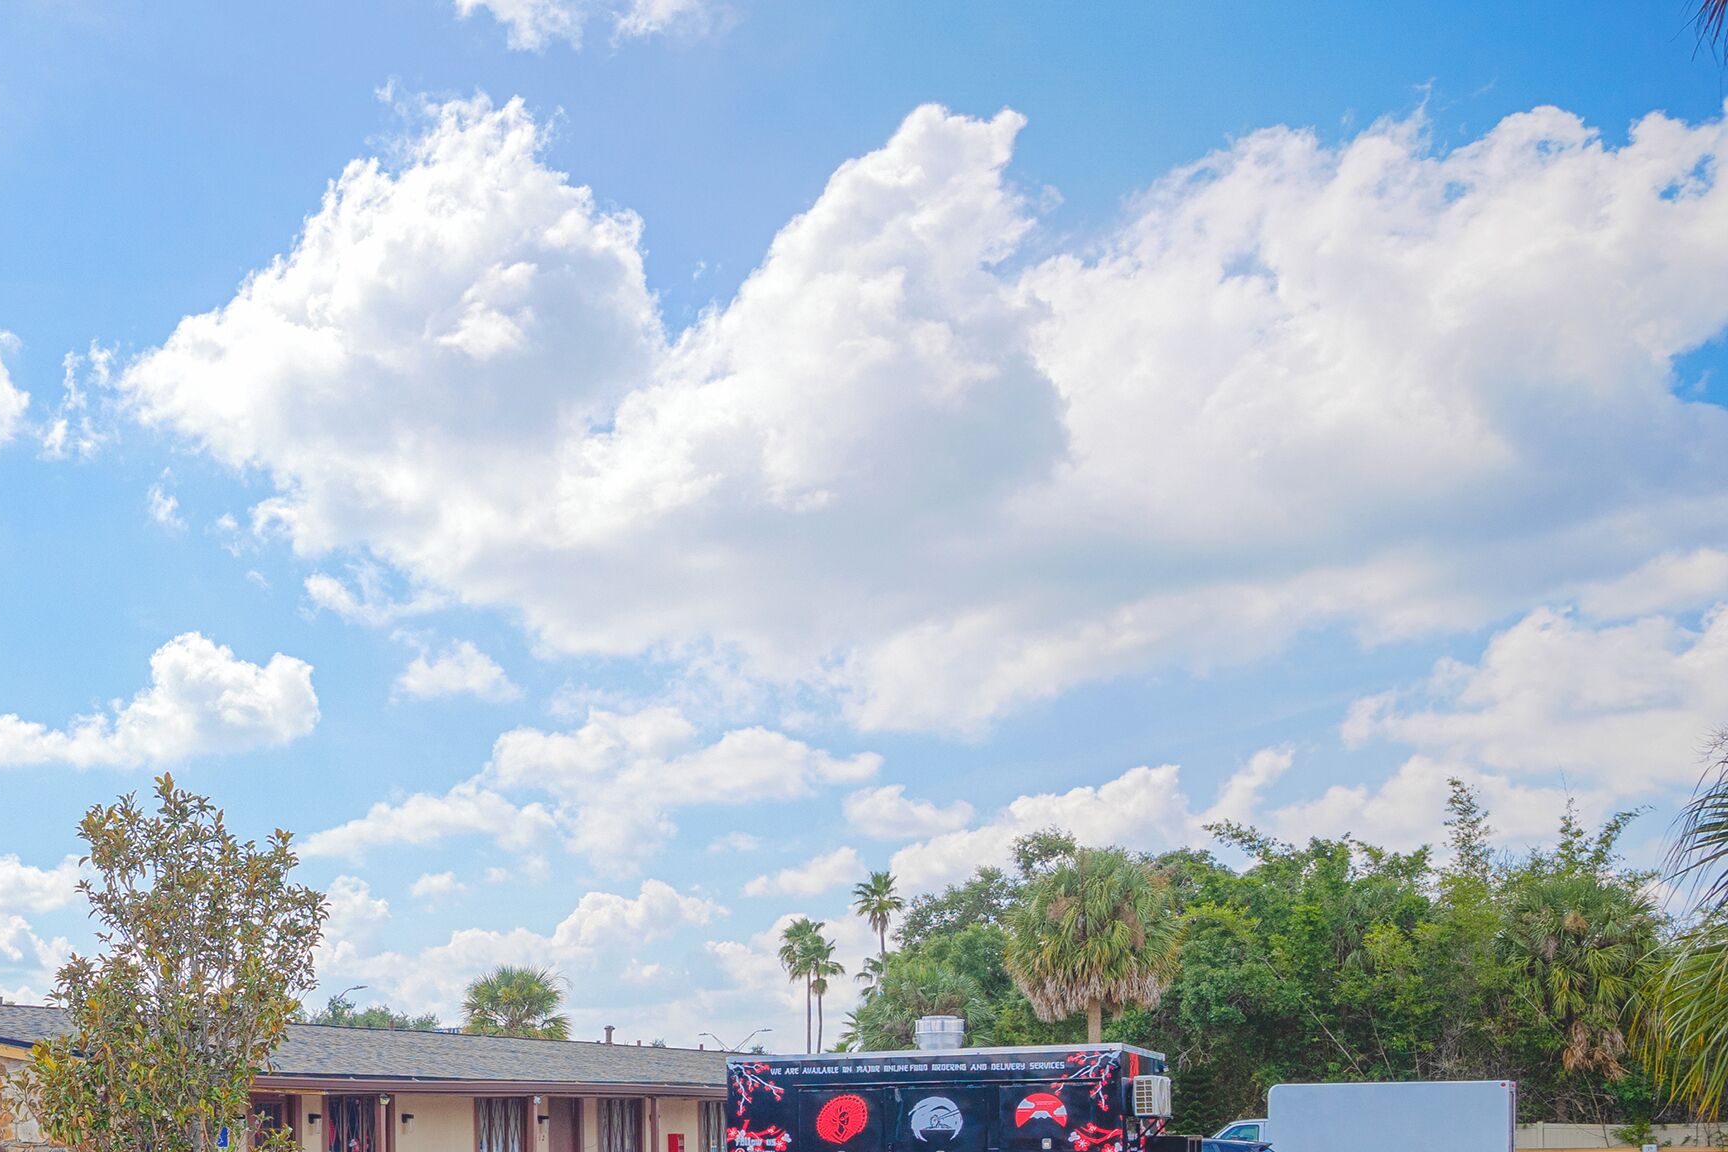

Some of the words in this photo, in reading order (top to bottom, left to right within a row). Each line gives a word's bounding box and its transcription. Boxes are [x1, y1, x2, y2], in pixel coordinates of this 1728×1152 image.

[785, 1067, 799, 1075] ARE
[802, 1066, 839, 1075] AVAILABLE
[842, 1065, 852, 1073] ON
[856, 1064, 881, 1073] MAJOR
[883, 1063, 909, 1073] ONLINE
[909, 1063, 928, 1072] FOOD
[932, 1062, 967, 1071] ORDERING
[970, 1063, 987, 1071] AND
[991, 1062, 1026, 1070] DELIVERY
[1029, 1061, 1065, 1069] SERVICES
